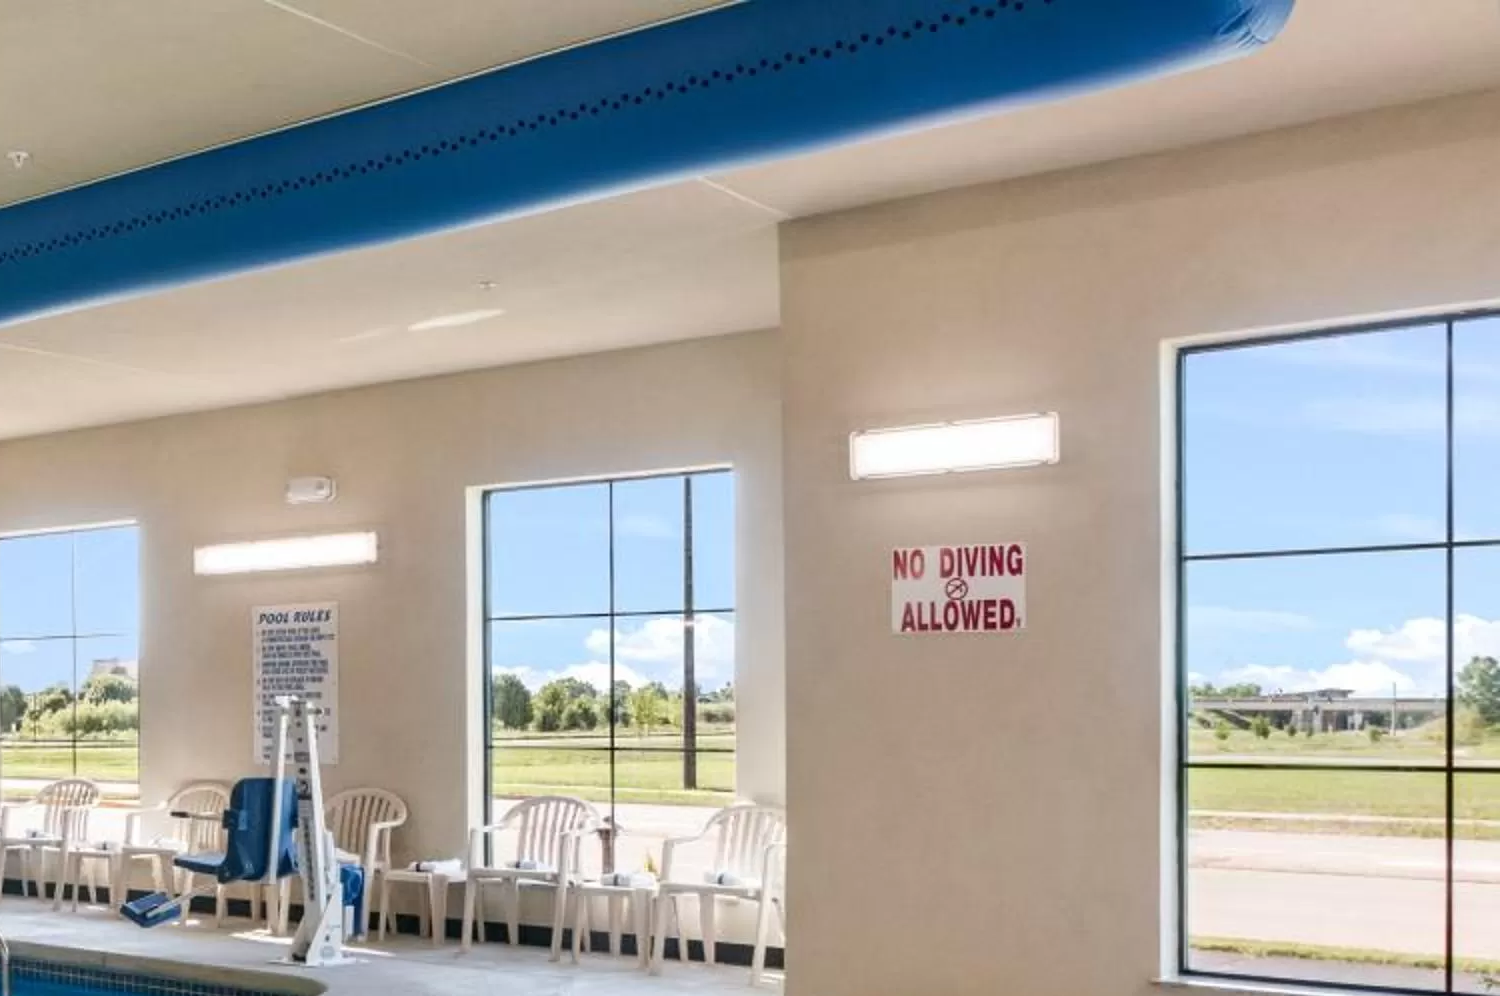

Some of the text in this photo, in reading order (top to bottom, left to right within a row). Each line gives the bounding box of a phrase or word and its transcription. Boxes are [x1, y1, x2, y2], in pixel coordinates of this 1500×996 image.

[893, 544, 1023, 579] NO DIVING
[258, 609, 332, 625] POOL RULES
